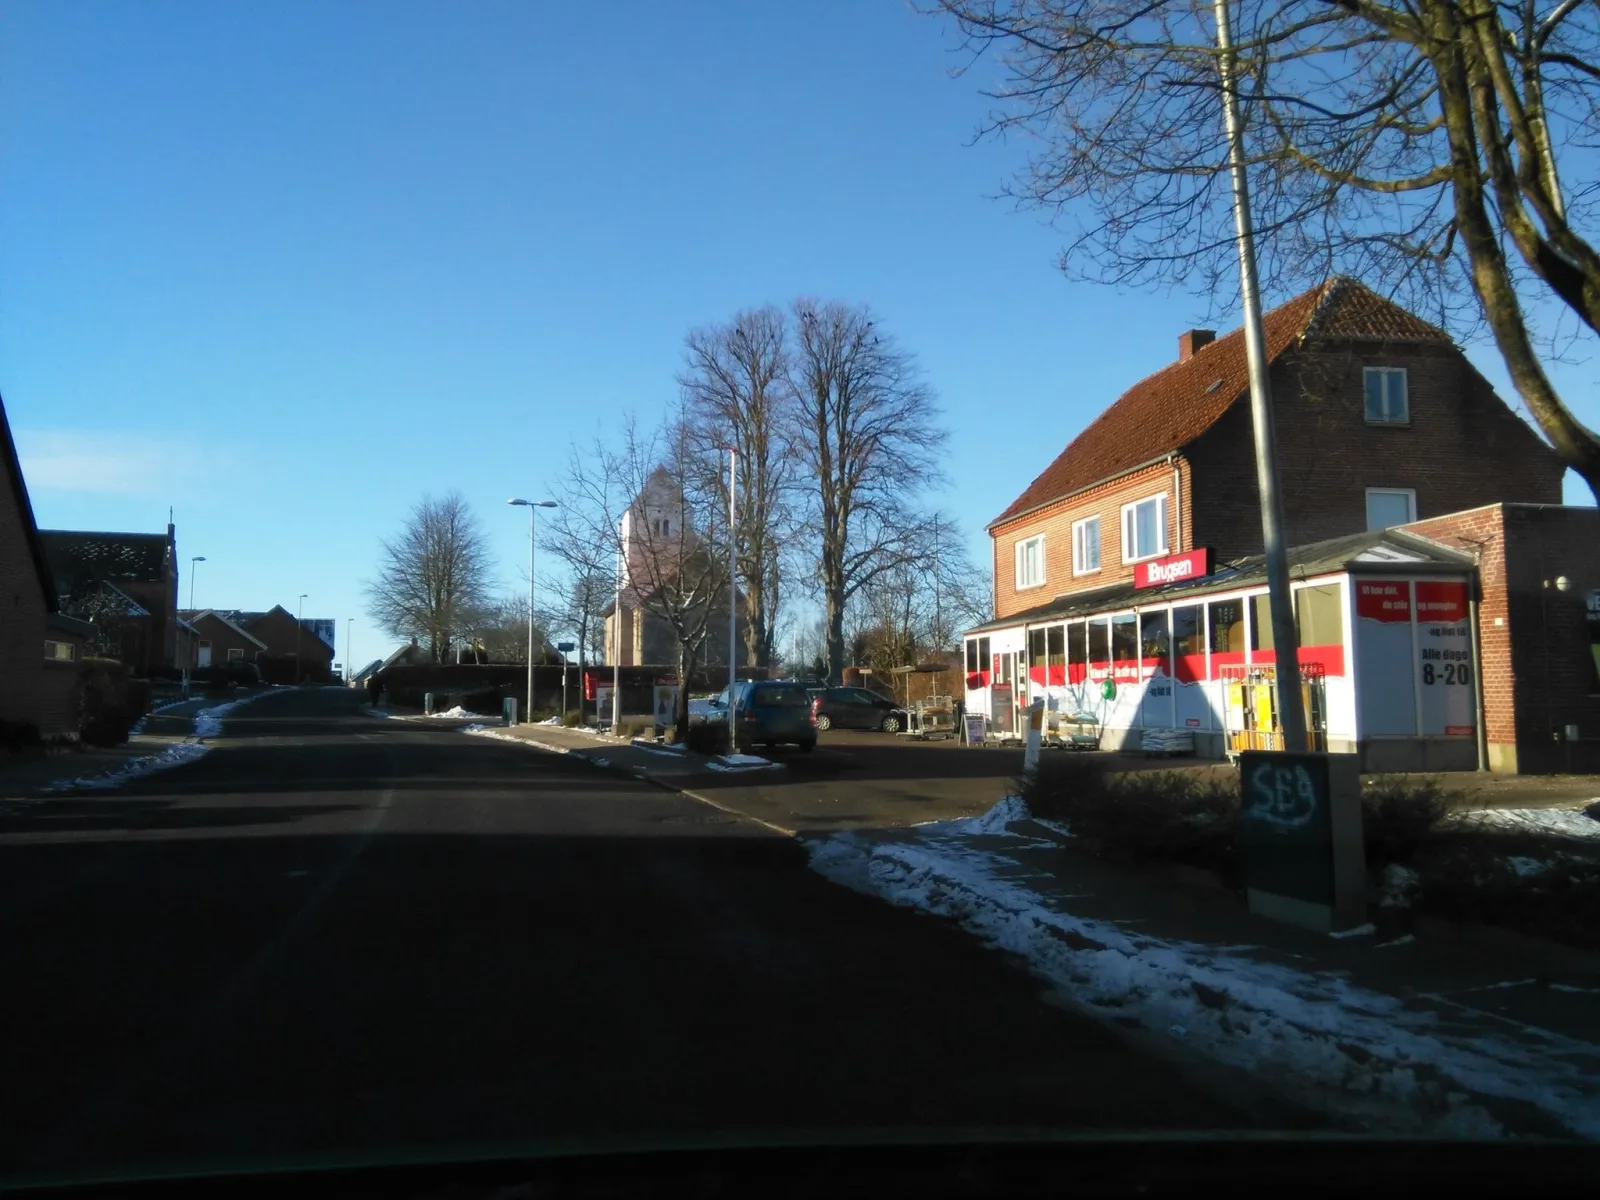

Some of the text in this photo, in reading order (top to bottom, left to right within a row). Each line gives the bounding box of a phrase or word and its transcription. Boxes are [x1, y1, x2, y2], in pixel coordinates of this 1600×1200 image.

[1147, 559, 1192, 583] Brugsen
[1422, 649, 1468, 661] Alle dage
[1423, 663, 1469, 686] 8-20
